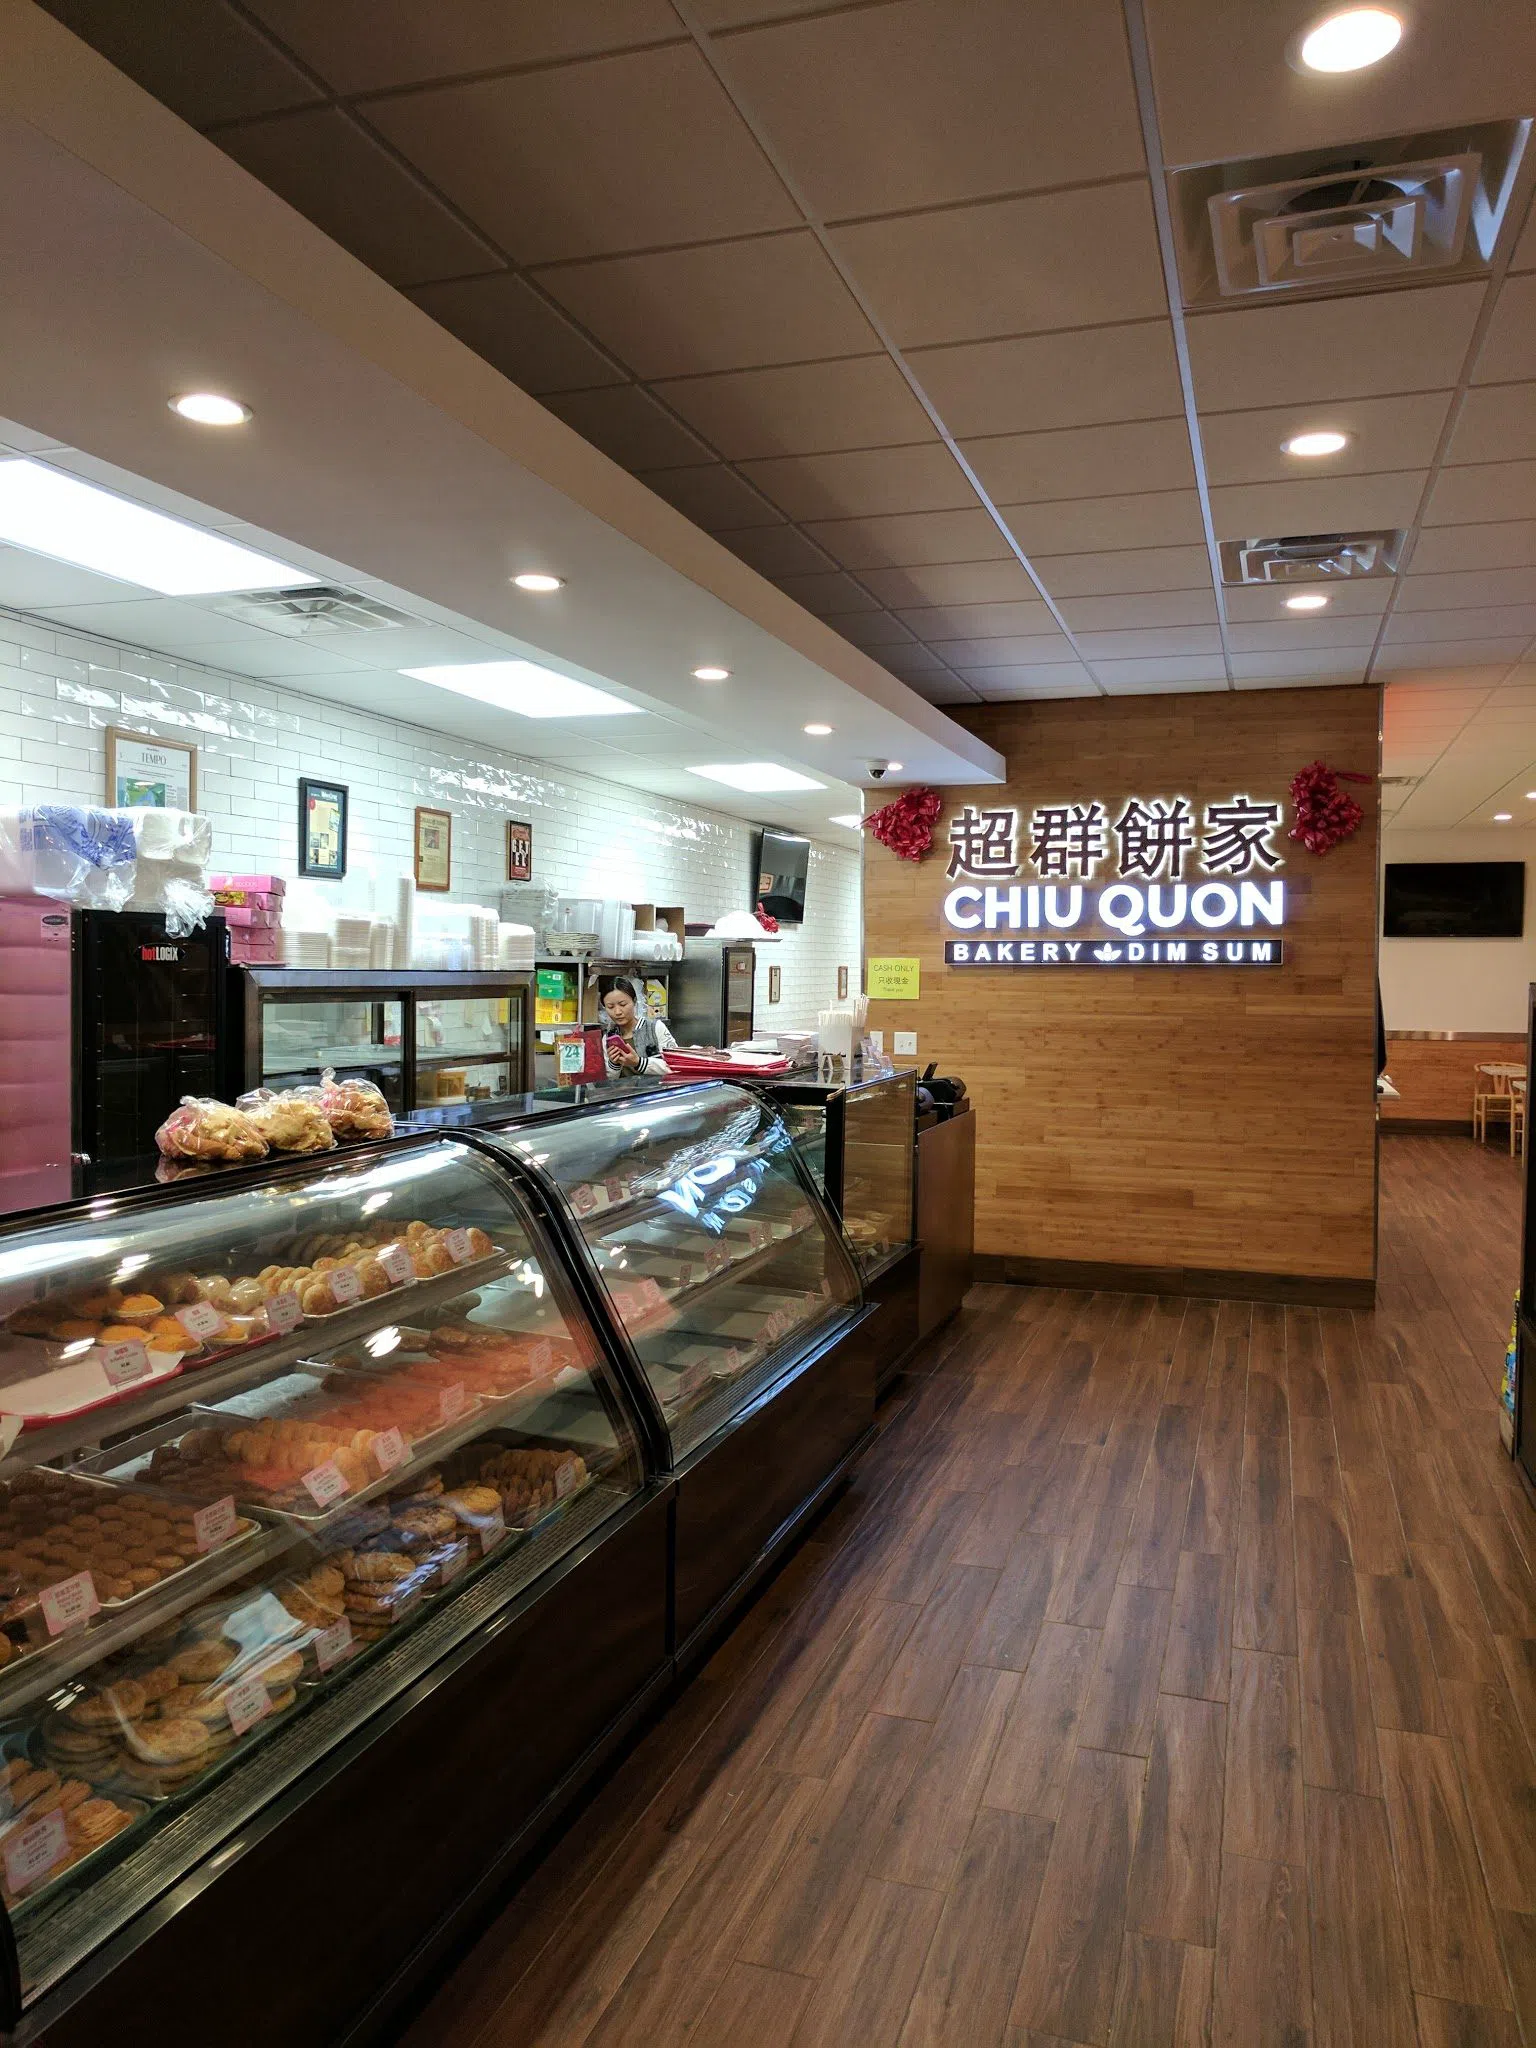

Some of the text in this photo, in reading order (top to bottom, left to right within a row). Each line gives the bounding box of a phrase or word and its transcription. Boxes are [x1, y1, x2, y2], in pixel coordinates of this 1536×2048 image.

[142, 752, 167, 766] TEMPO
[946, 798, 1281, 879] 超群餅家
[944, 880, 1283, 937] CHIU QUON
[142, 945, 178, 961] hotLOGIX
[953, 942, 1271, 962] BAKERY DIM SUM
[874, 964, 893, 972] CASH
[565, 1045, 580, 1058] 24
